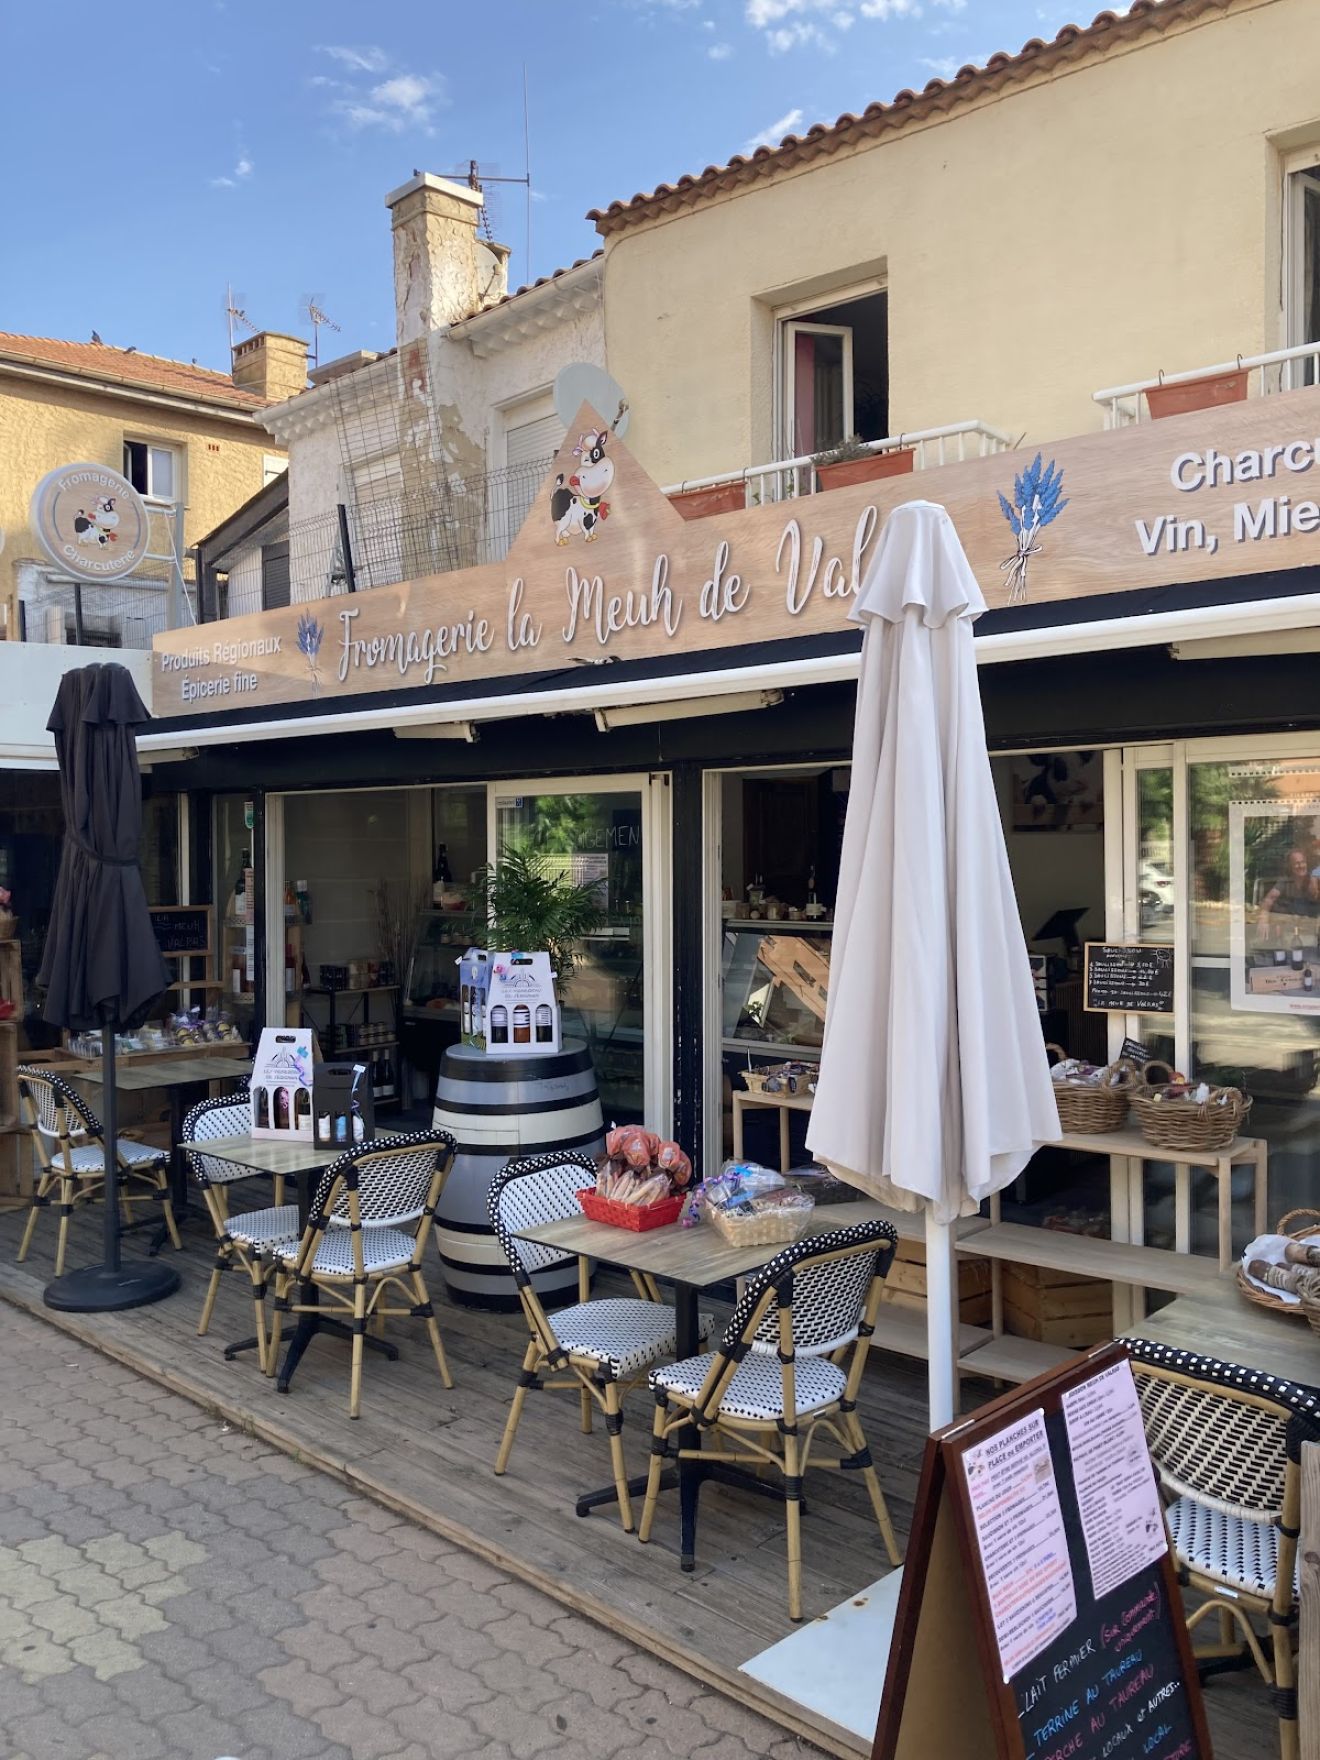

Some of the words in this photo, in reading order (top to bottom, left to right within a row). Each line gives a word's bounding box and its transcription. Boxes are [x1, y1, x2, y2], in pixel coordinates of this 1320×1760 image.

[58, 471, 131, 499] Fromagerie
[1135, 514, 1219, 555] Vin,
[1233, 495, 1320, 543] Mie
[63, 544, 136, 571] Charcuterie
[338, 606, 494, 685] Fromagerie
[507, 577, 542, 651] la
[563, 553, 683, 644] Meuh
[699, 541, 750, 622] de
[776, 505, 880, 616] Val
[161, 645, 210, 673] Produits
[213, 636, 283, 668] Régionaux
[181, 671, 230, 702] Épicerie
[232, 671, 259, 694] fine
[985, 1443, 998, 1456] NOS
[998, 1426, 1027, 1448] PLANCHES
[1028, 1419, 1039, 1431] SUR
[988, 1452, 1006, 1469] PLACE
[1014, 1430, 1043, 1452] EMPORTER
[1033, 1699, 1080, 1748] TERRINE
[1086, 1684, 1100, 1706] AU
[1102, 1649, 1144, 1686] TAUREAU
[1090, 1712, 1106, 1734] AU
[1109, 1664, 1154, 1712] TAUREAU
[1102, 1723, 1134, 1758] LOCAUX
